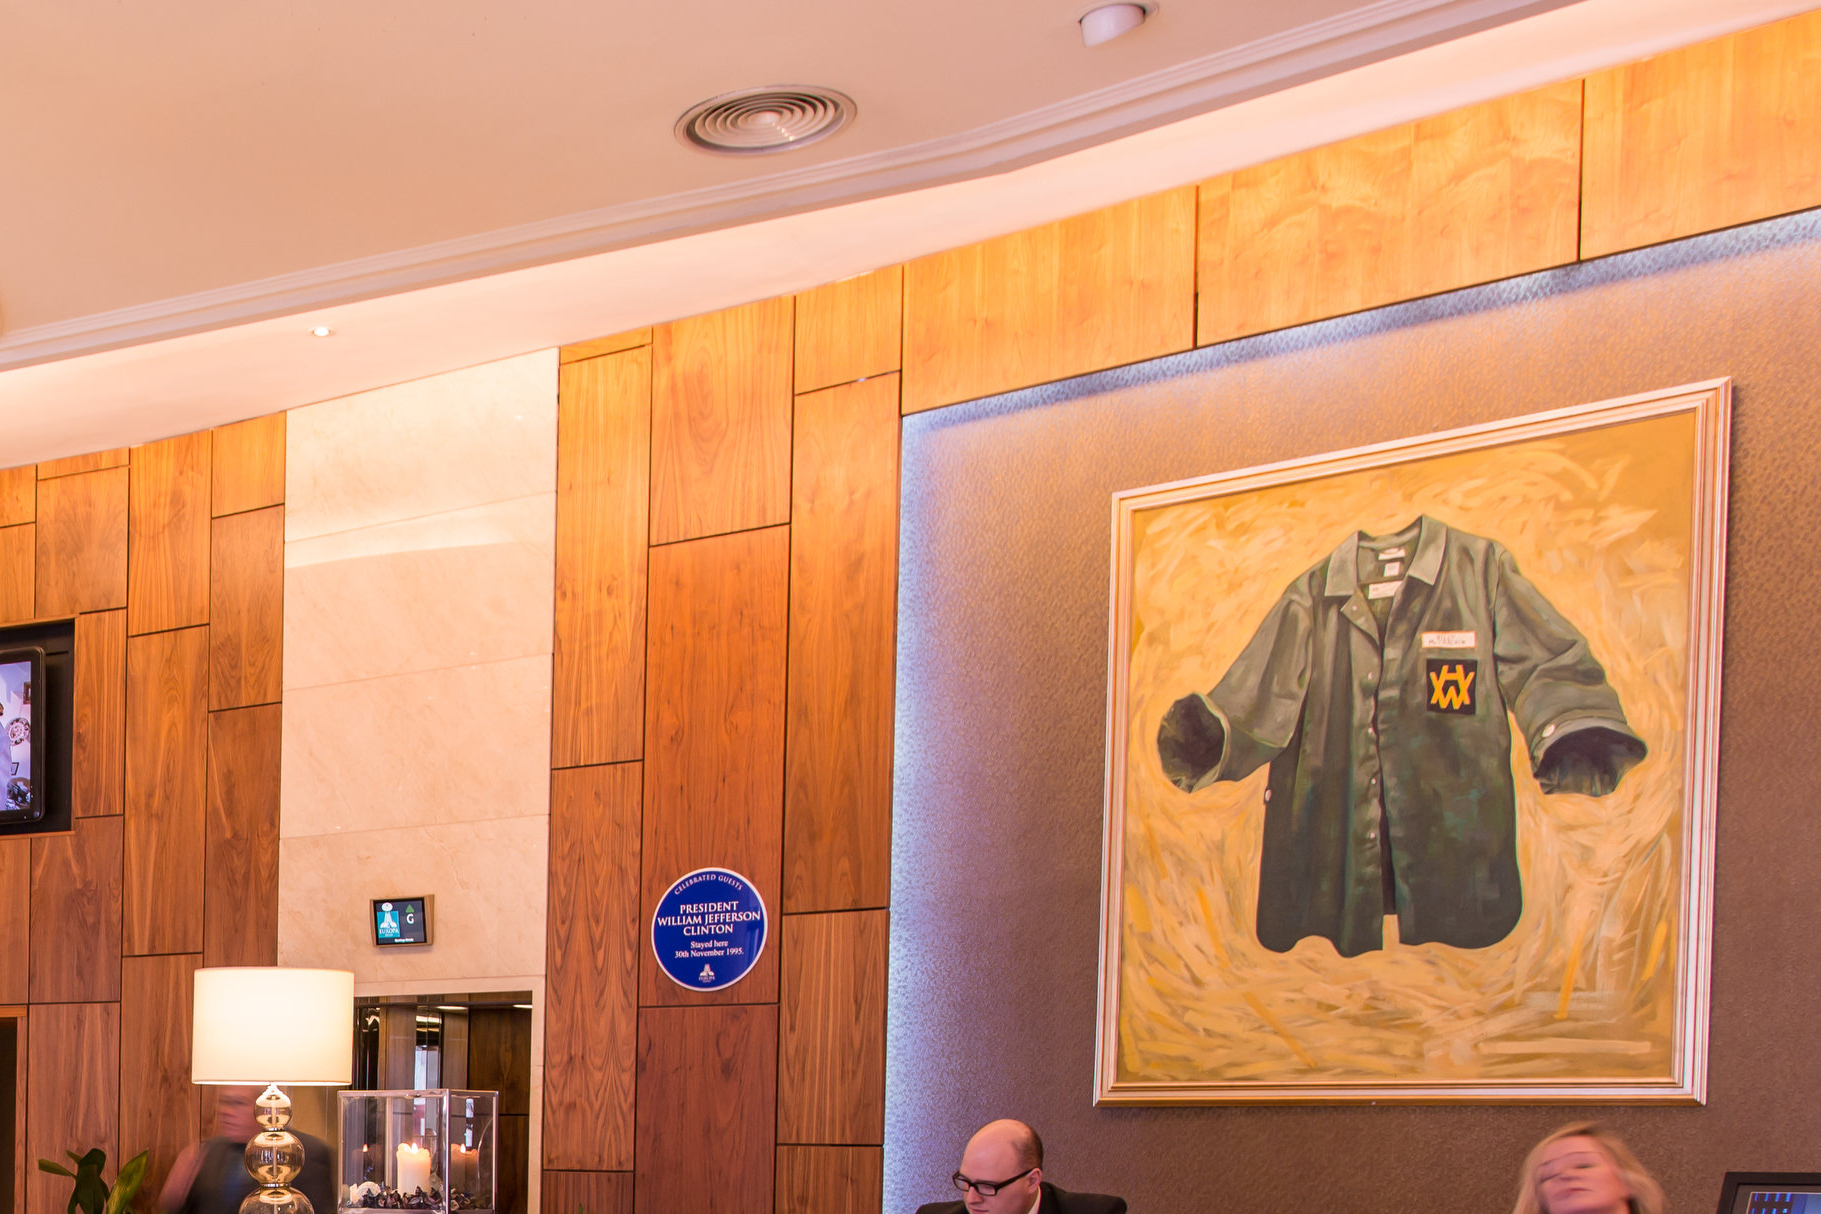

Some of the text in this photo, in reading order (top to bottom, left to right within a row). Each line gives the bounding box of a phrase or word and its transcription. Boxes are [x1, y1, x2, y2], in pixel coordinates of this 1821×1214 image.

[674, 874, 743, 895] CELEBRATED GUESTS
[679, 901, 739, 914] PRESIDENT
[406, 913, 415, 924] G
[657, 911, 760, 926] WILLIAM JEFFERSON
[683, 924, 733, 936] CLINTON
[690, 940, 729, 950] Stayed here
[674, 950, 689, 959] 30th
[690, 949, 725, 958] November
